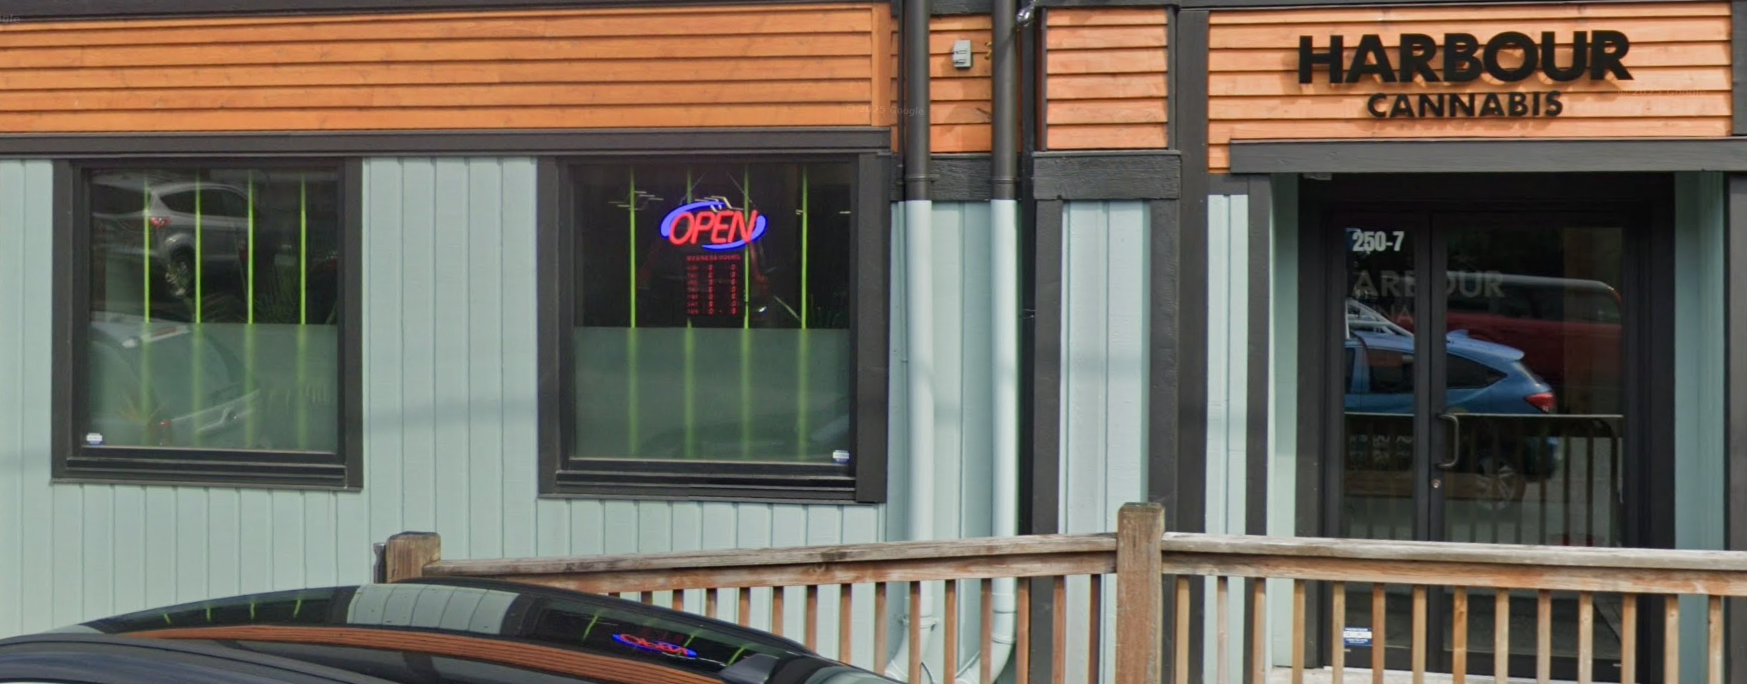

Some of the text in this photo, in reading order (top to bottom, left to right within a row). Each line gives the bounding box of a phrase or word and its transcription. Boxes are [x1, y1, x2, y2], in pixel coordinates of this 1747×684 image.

[1299, 30, 1633, 84] HARBOUR
[1367, 91, 1564, 118] CANNABIS
[668, 209, 757, 247] OPEN
[1352, 231, 1404, 252] 250-7
